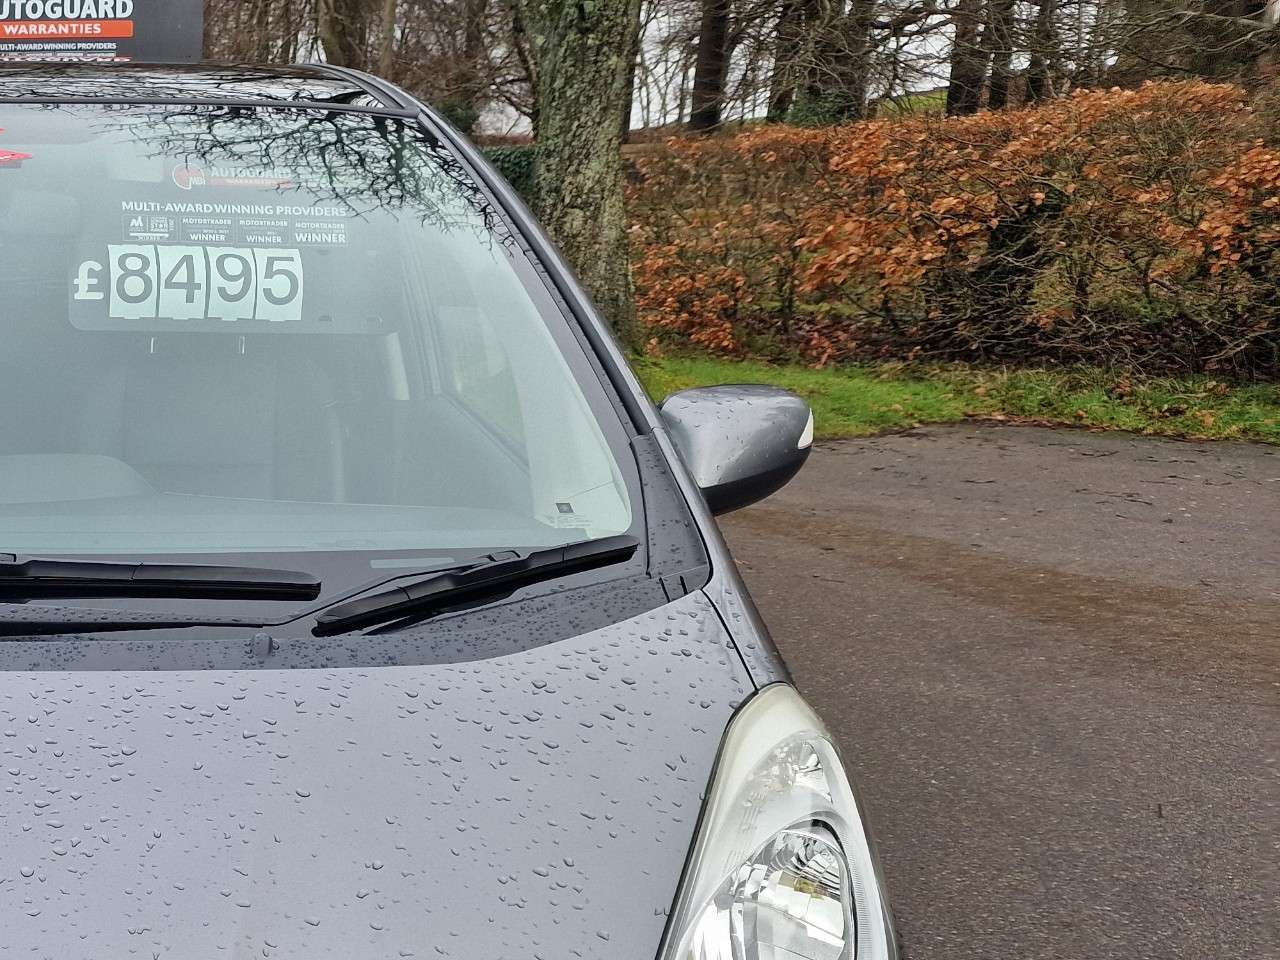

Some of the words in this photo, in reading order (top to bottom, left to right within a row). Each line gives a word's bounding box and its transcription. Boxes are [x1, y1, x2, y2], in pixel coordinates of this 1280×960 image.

[4, 23, 102, 35] WARRANTIES
[43, 42, 77, 51] WINNING
[77, 42, 117, 50] PROVIDERS
[122, 201, 213, 213] MULTI-AWARD
[214, 203, 274, 215] WINNING
[276, 205, 347, 217] PROVIDERS
[190, 233, 226, 241] WINNER
[246, 235, 282, 243] WINNER
[295, 232, 346, 243] WINNER
